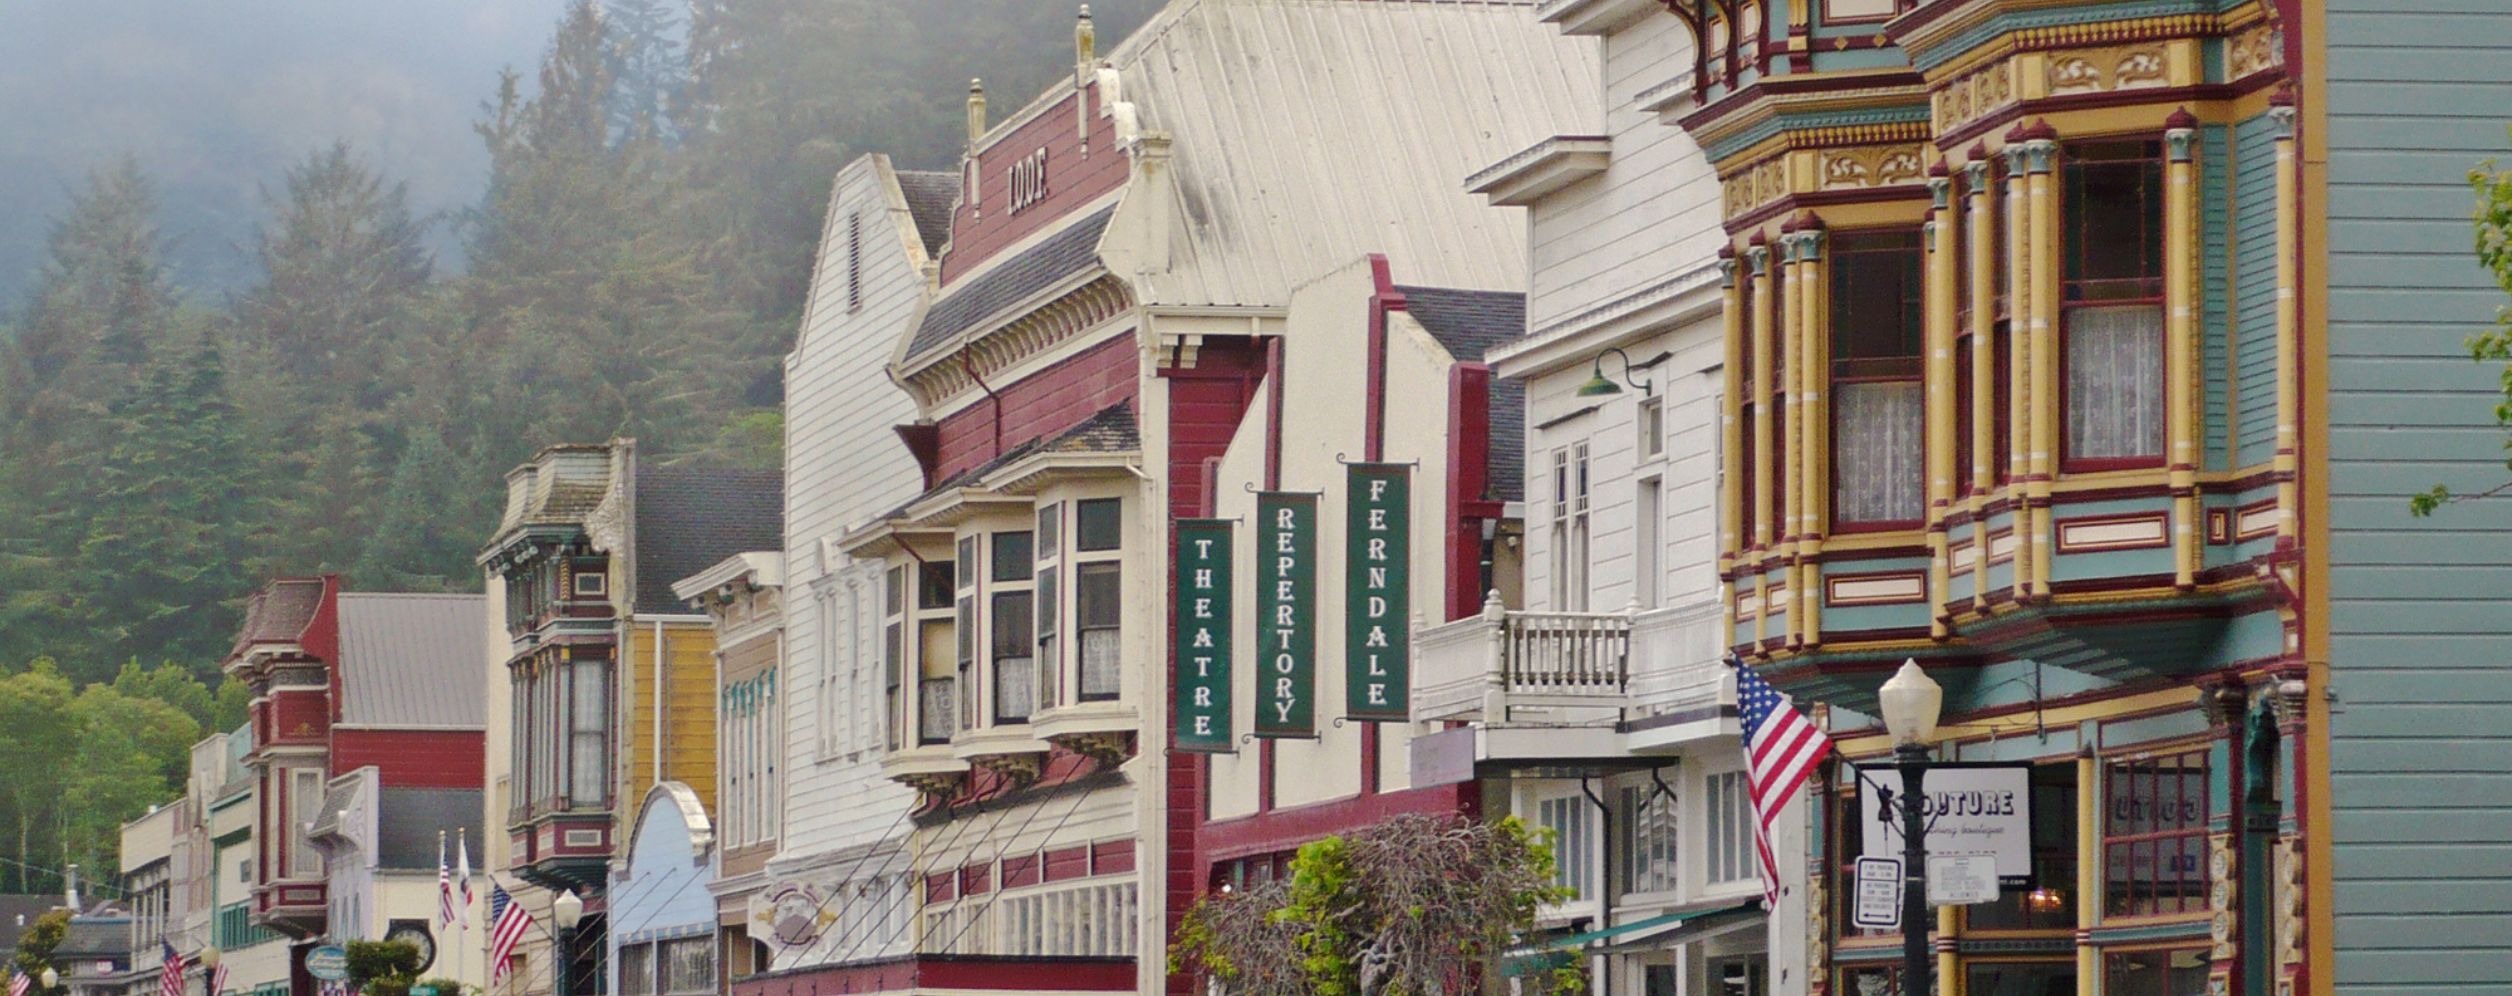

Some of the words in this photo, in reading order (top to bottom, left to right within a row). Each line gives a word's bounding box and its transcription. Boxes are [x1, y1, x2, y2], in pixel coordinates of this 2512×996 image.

[1193, 539, 1213, 735] THEATRE
[1276, 508, 1296, 723] REPERTORY
[1366, 479, 1388, 705] FERNDALE
[1921, 790, 2014, 816] OUTURE
